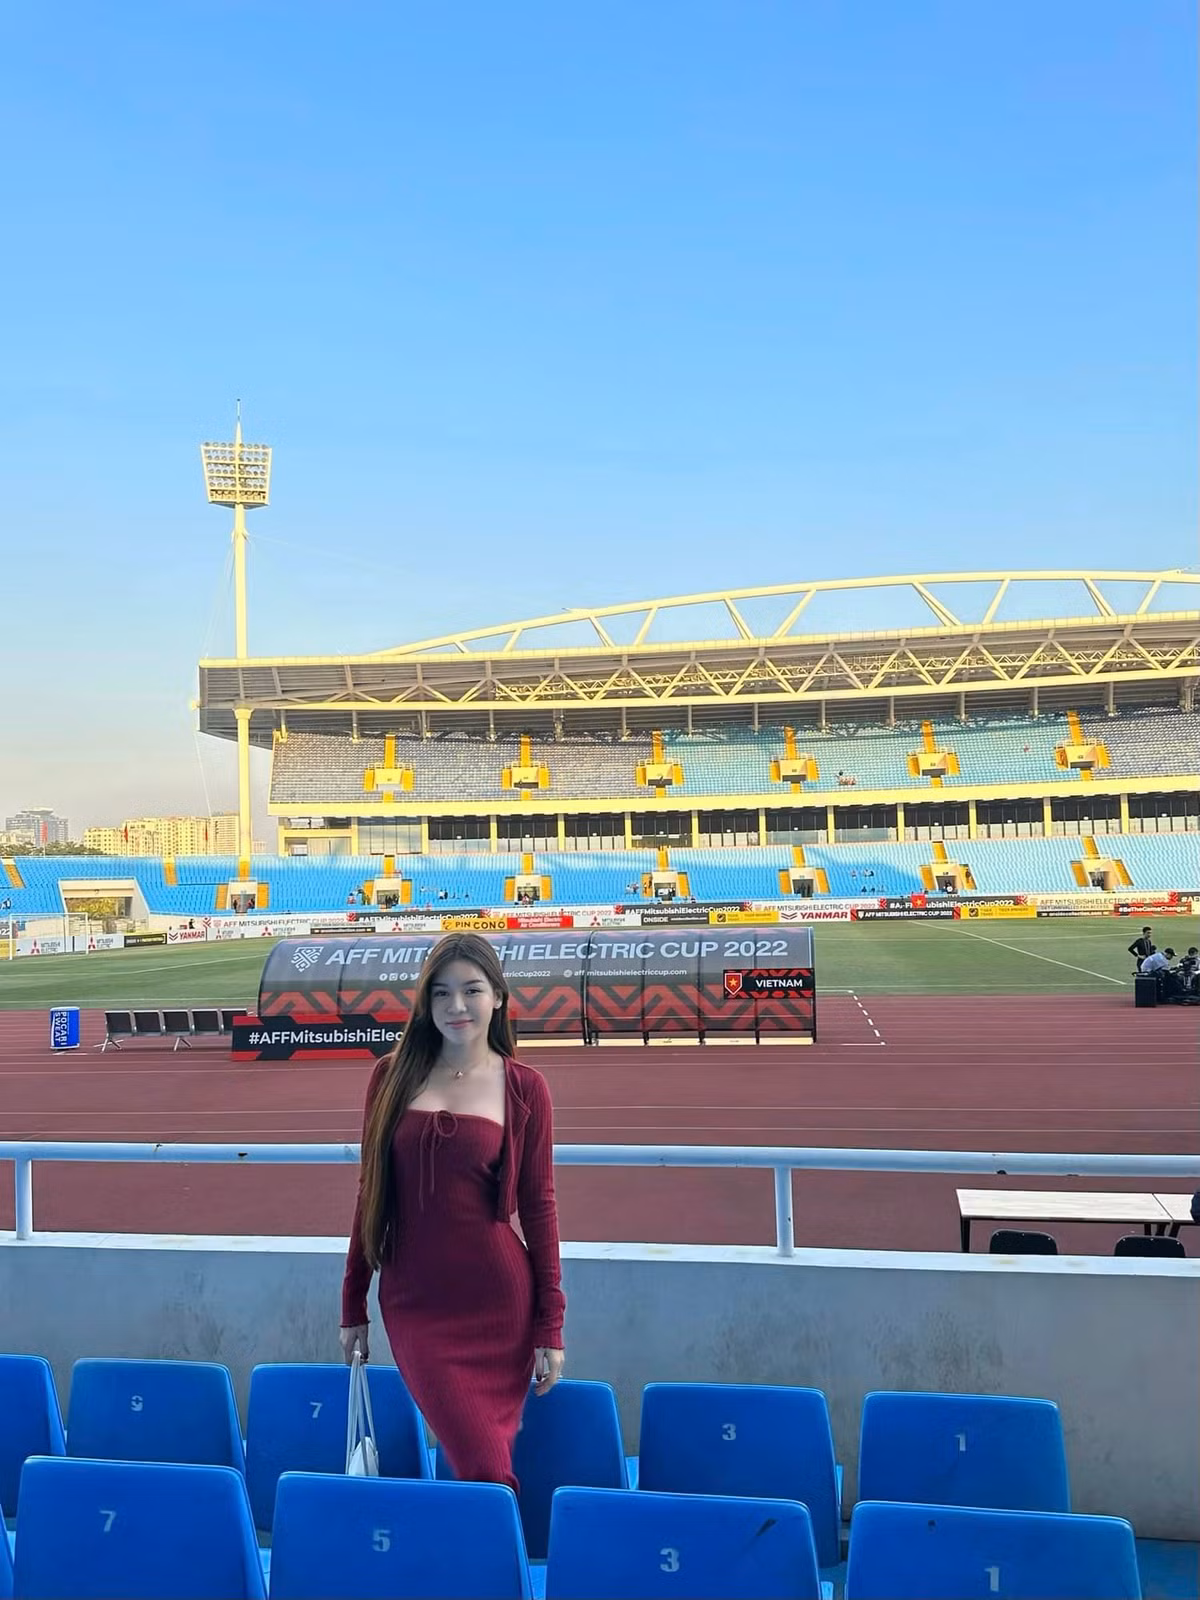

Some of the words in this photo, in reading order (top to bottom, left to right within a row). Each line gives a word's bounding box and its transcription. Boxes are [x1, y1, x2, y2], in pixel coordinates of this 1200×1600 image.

[800, 911, 848, 919] YANMAR
[180, 931, 205, 939] YANMAR
[473, 921, 496, 930] CON
[325, 948, 378, 966] AFF
[528, 942, 654, 961] ELECTRIC
[667, 941, 718, 958] CUP
[723, 940, 788, 957] 2022
[755, 978, 803, 989] VIETNAM
[60, 1011, 68, 1046] POCARI
[309, 1400, 323, 1419] 7
[722, 1423, 737, 1441] 3
[953, 1433, 966, 1452] 1
[98, 1509, 117, 1532] 7
[372, 1529, 391, 1553] 5
[660, 1547, 680, 1573] 3
[984, 1566, 1000, 1593] 1
